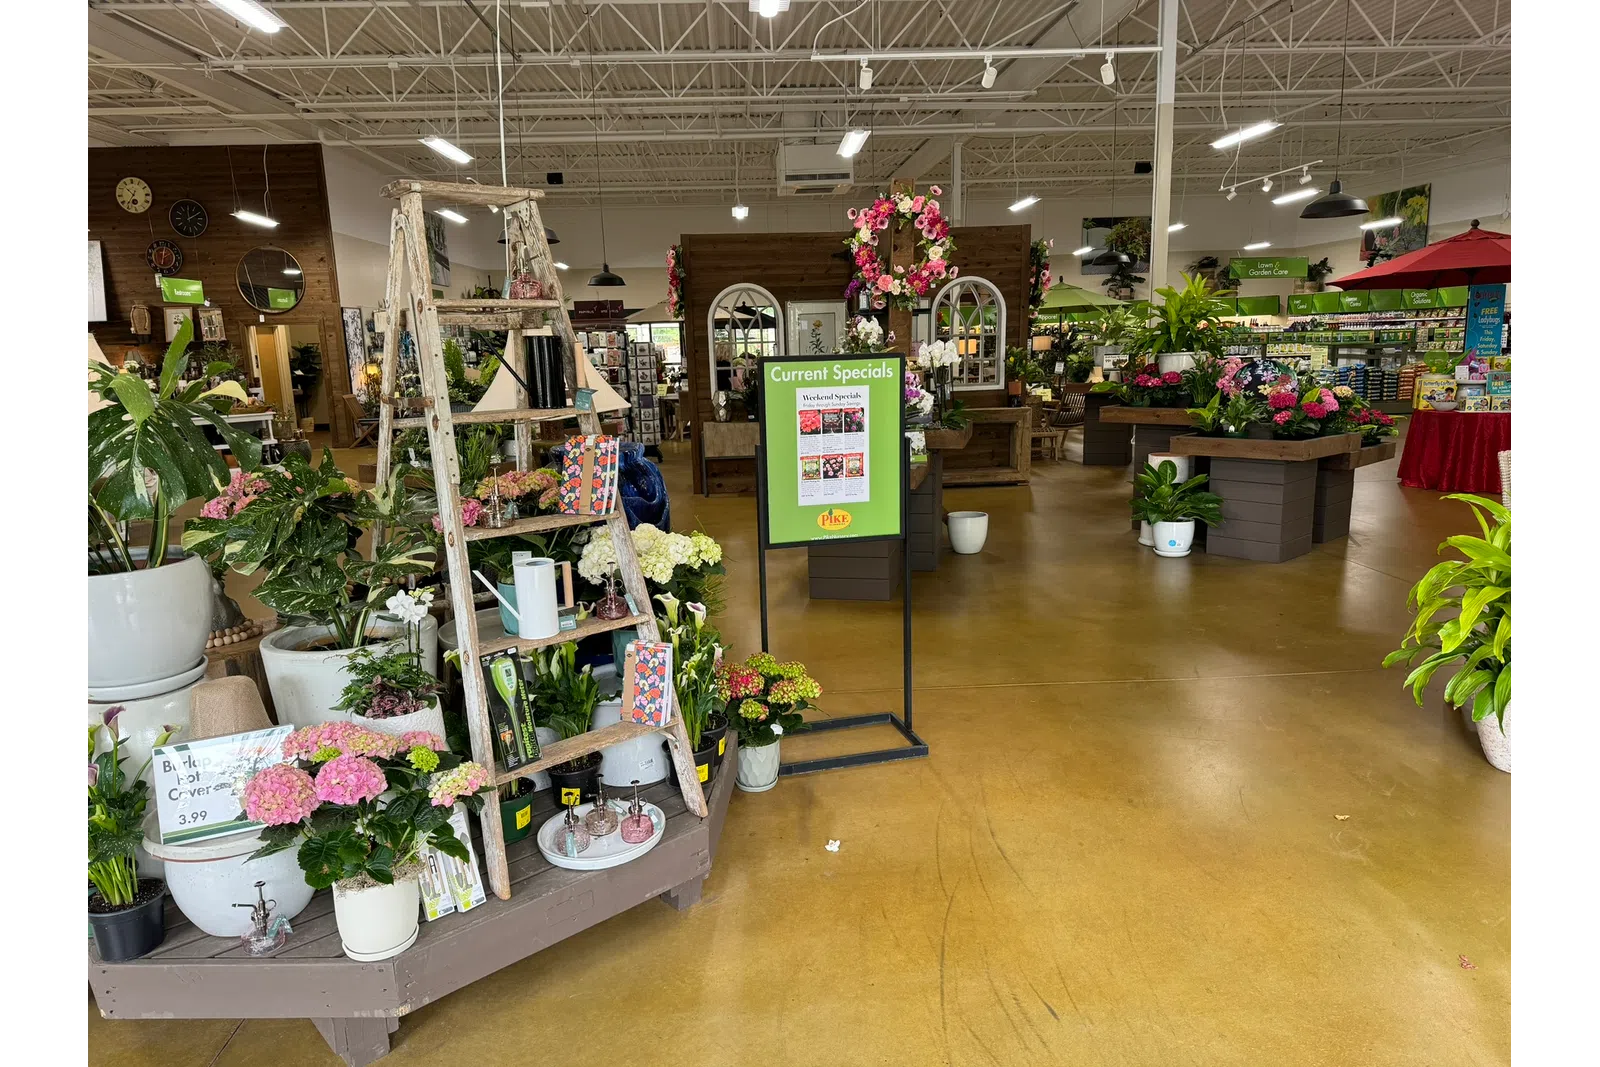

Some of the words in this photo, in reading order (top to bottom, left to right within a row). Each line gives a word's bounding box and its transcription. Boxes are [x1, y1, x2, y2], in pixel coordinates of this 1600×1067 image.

[1248, 268, 1272, 276] Garden
[1410, 291, 1428, 299] Organic
[1481, 306, 1499, 315] FREE
[1478, 316, 1500, 325] Ladybugs
[770, 366, 829, 382] Current
[833, 361, 893, 384] Specials
[802, 393, 834, 401] Weekend
[834, 392, 862, 401] Specials
[518, 679, 527, 700] Meter
[520, 722, 534, 759] rapitest
[178, 810, 208, 825] 3.99
